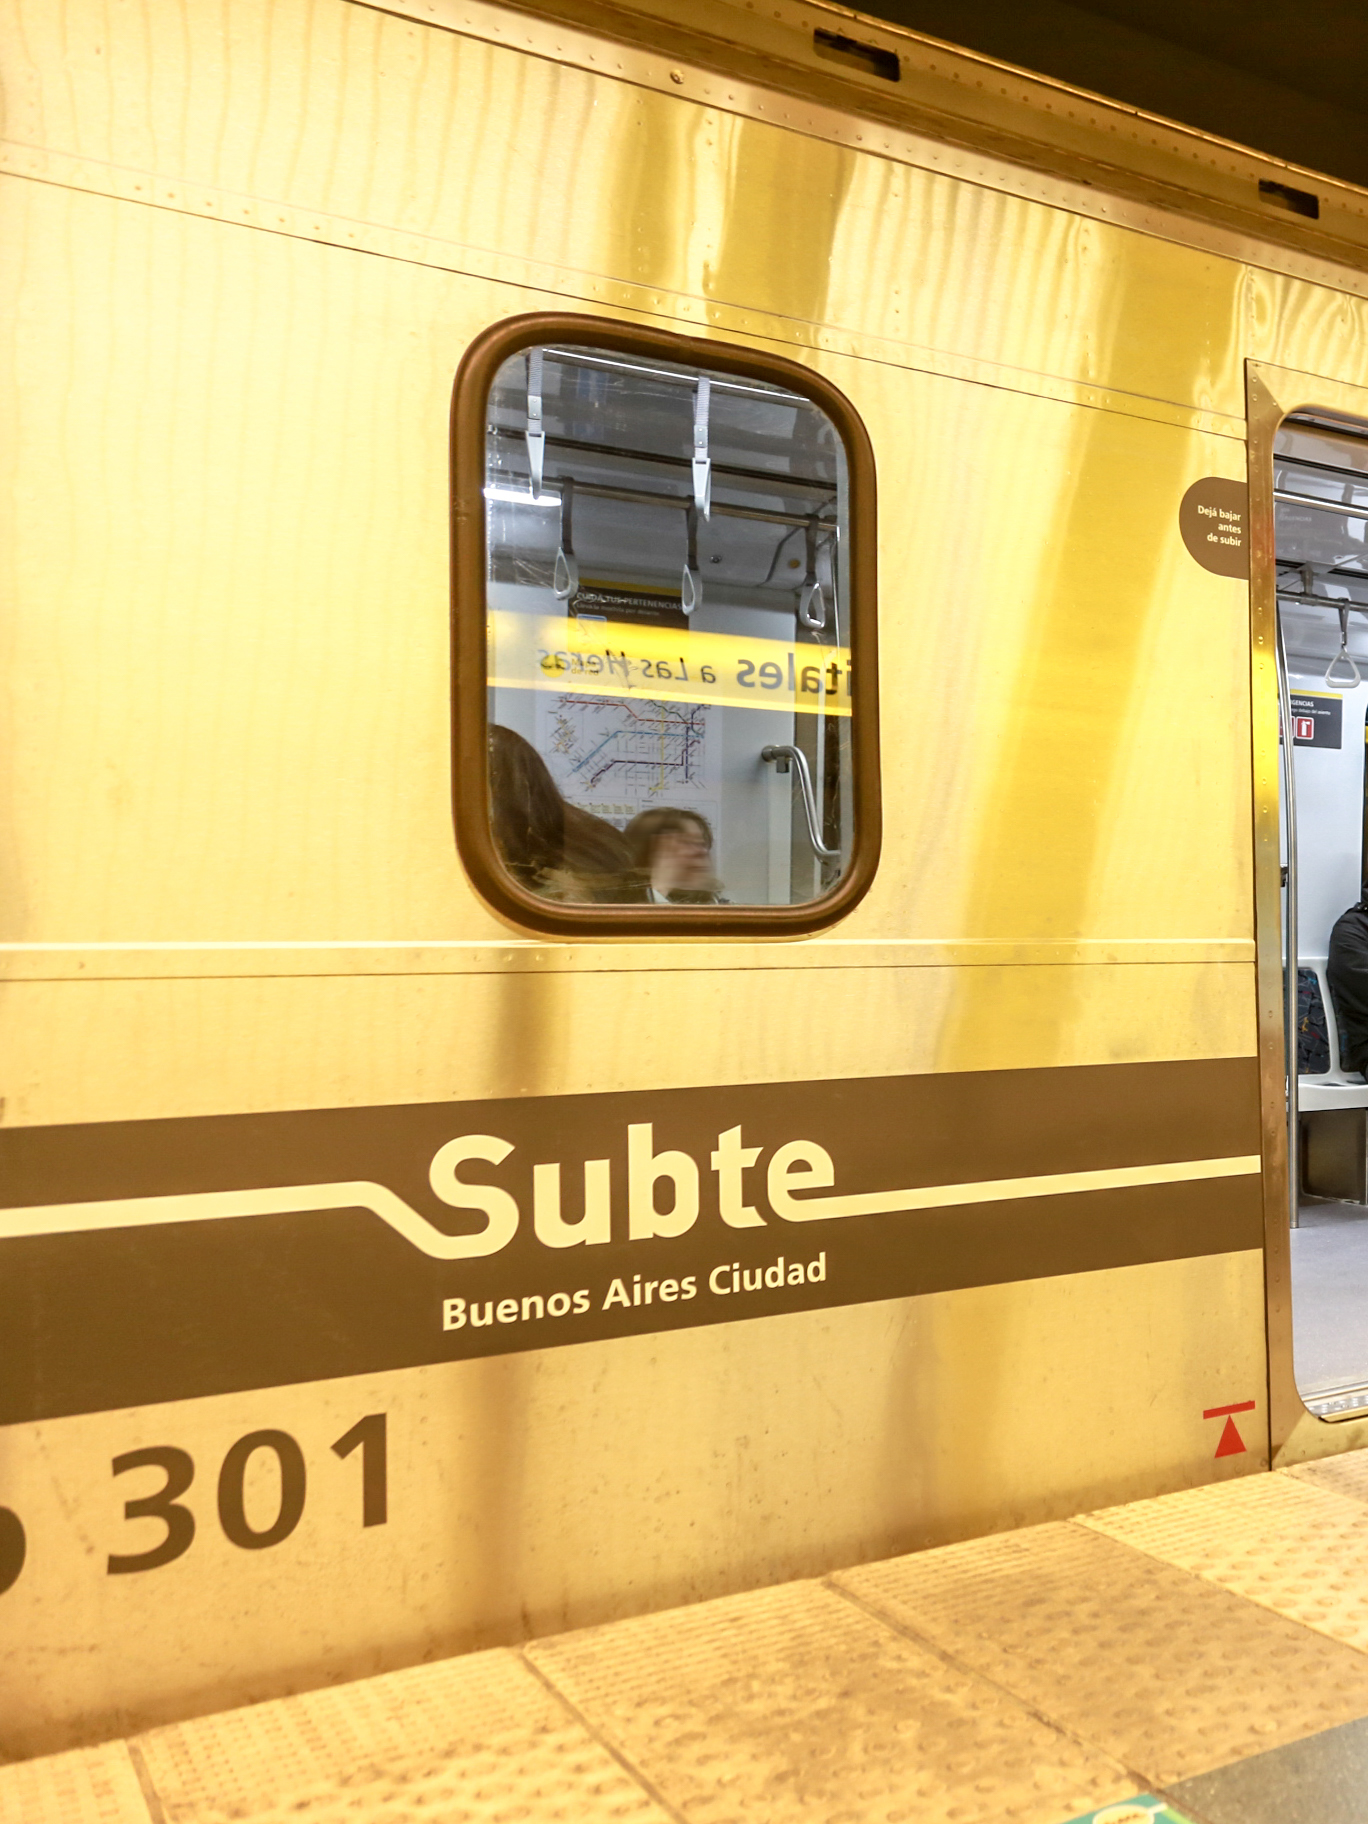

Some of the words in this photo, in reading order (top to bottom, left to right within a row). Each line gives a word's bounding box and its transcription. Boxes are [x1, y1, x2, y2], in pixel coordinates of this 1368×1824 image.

[1197, 505, 1217, 518] Dejá
[1219, 508, 1241, 522] bajar
[1218, 523, 1241, 534] antes
[1207, 532, 1218, 543] de
[1220, 536, 1241, 547] subir
[428, 1121, 836, 1260] Subte
[441, 1286, 591, 1332] Buenos
[602, 1274, 699, 1311] Aires
[707, 1251, 828, 1298] Ciudad
[105, 1411, 389, 1577] 301
